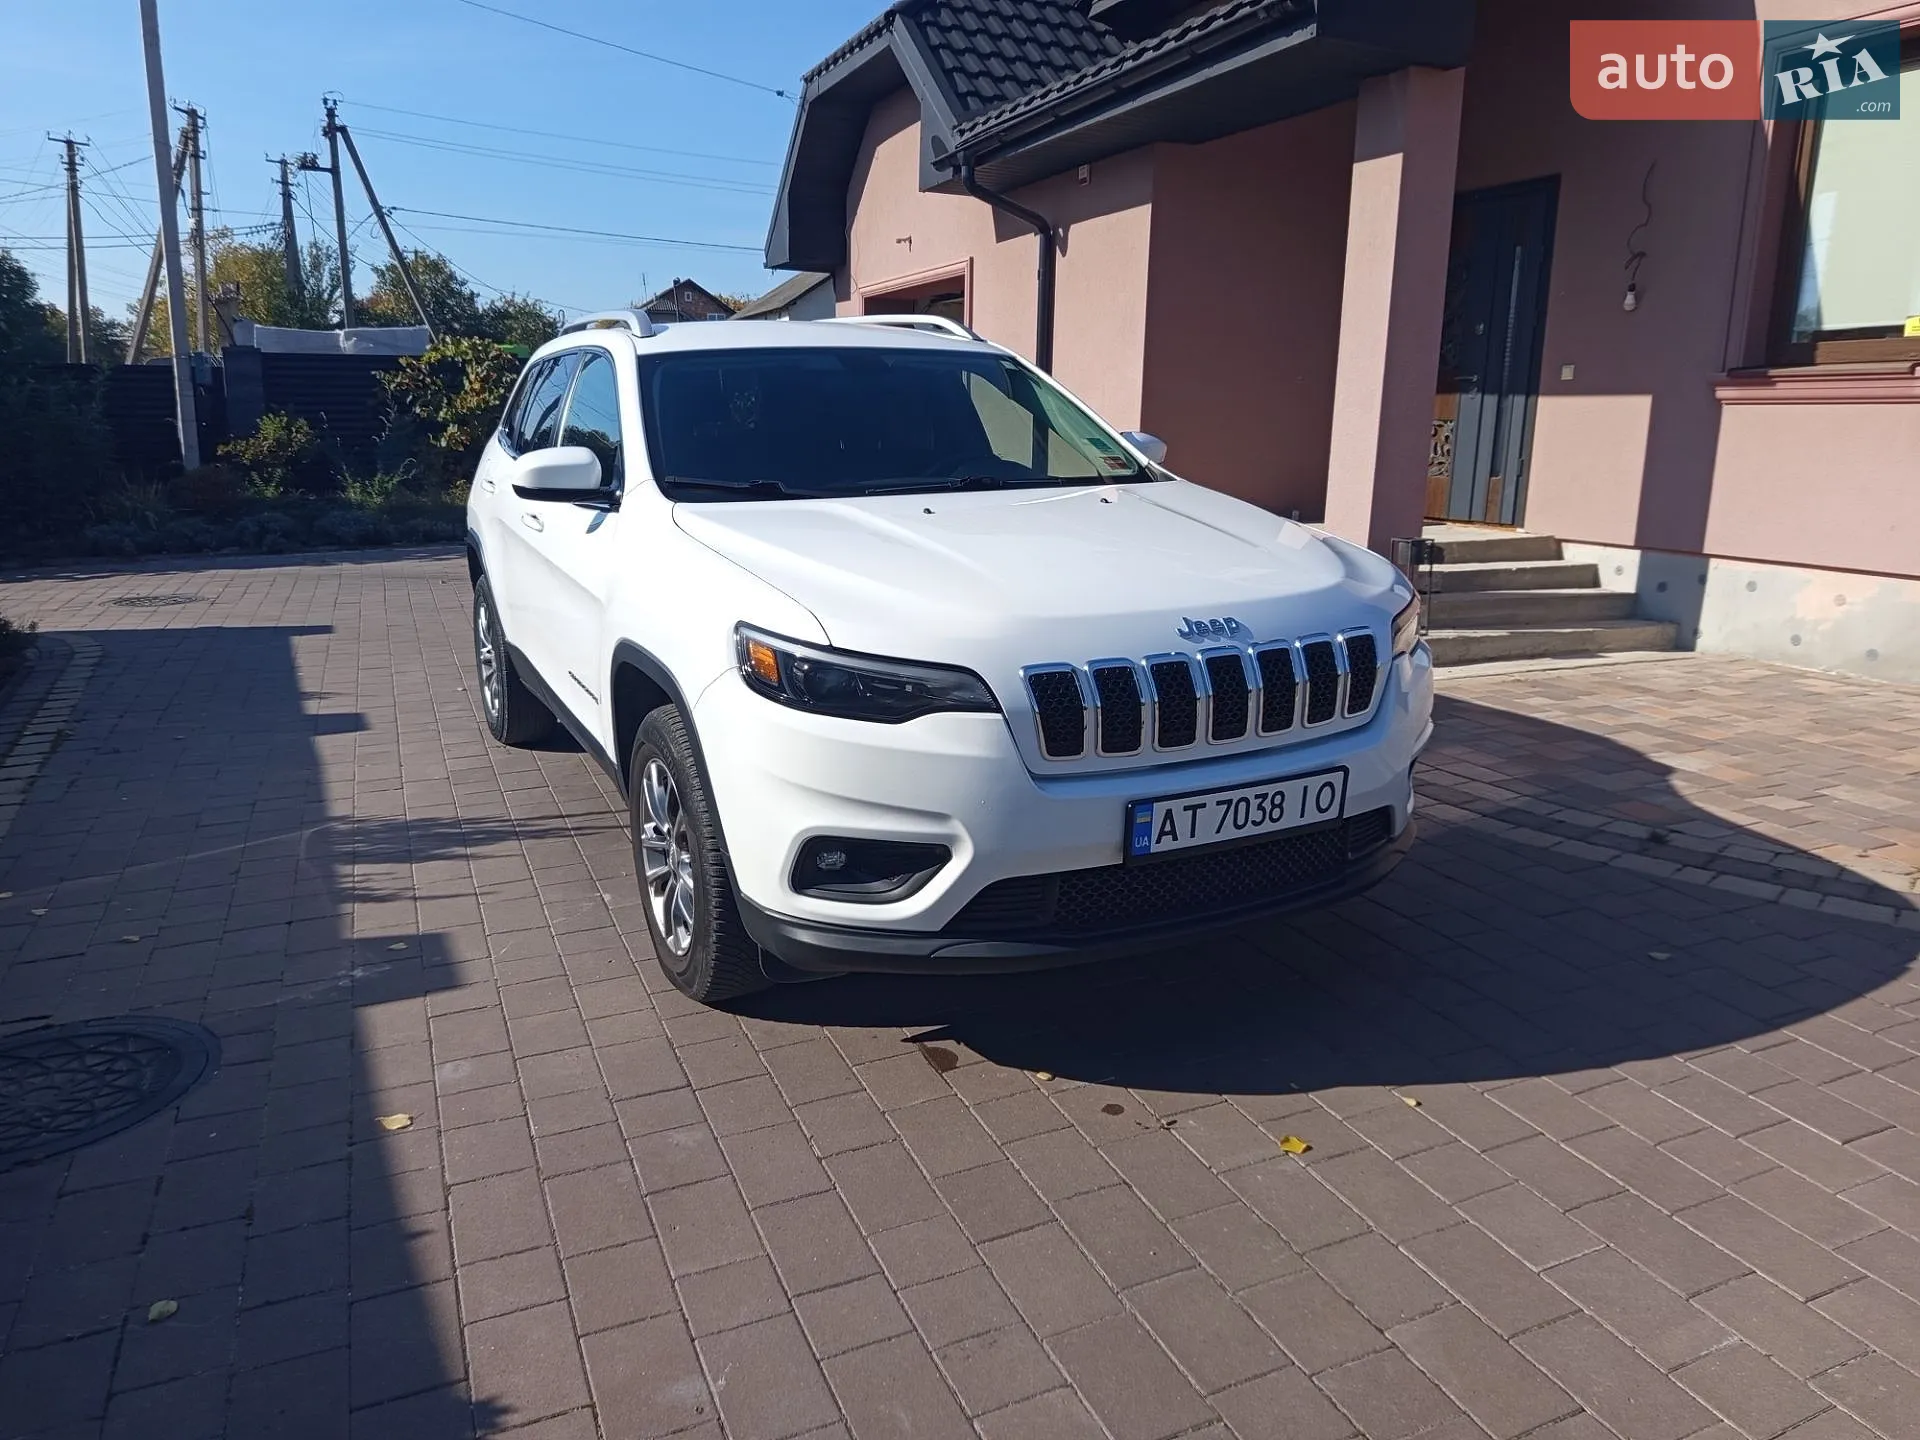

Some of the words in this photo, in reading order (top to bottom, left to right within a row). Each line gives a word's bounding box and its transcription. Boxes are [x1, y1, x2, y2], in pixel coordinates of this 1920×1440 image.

[1175, 616, 1241, 640] Jeep
[1155, 802, 1207, 845] AT
[1215, 790, 1286, 835] 7038
[1300, 781, 1336, 819] IO
[1134, 836, 1149, 848] UA
